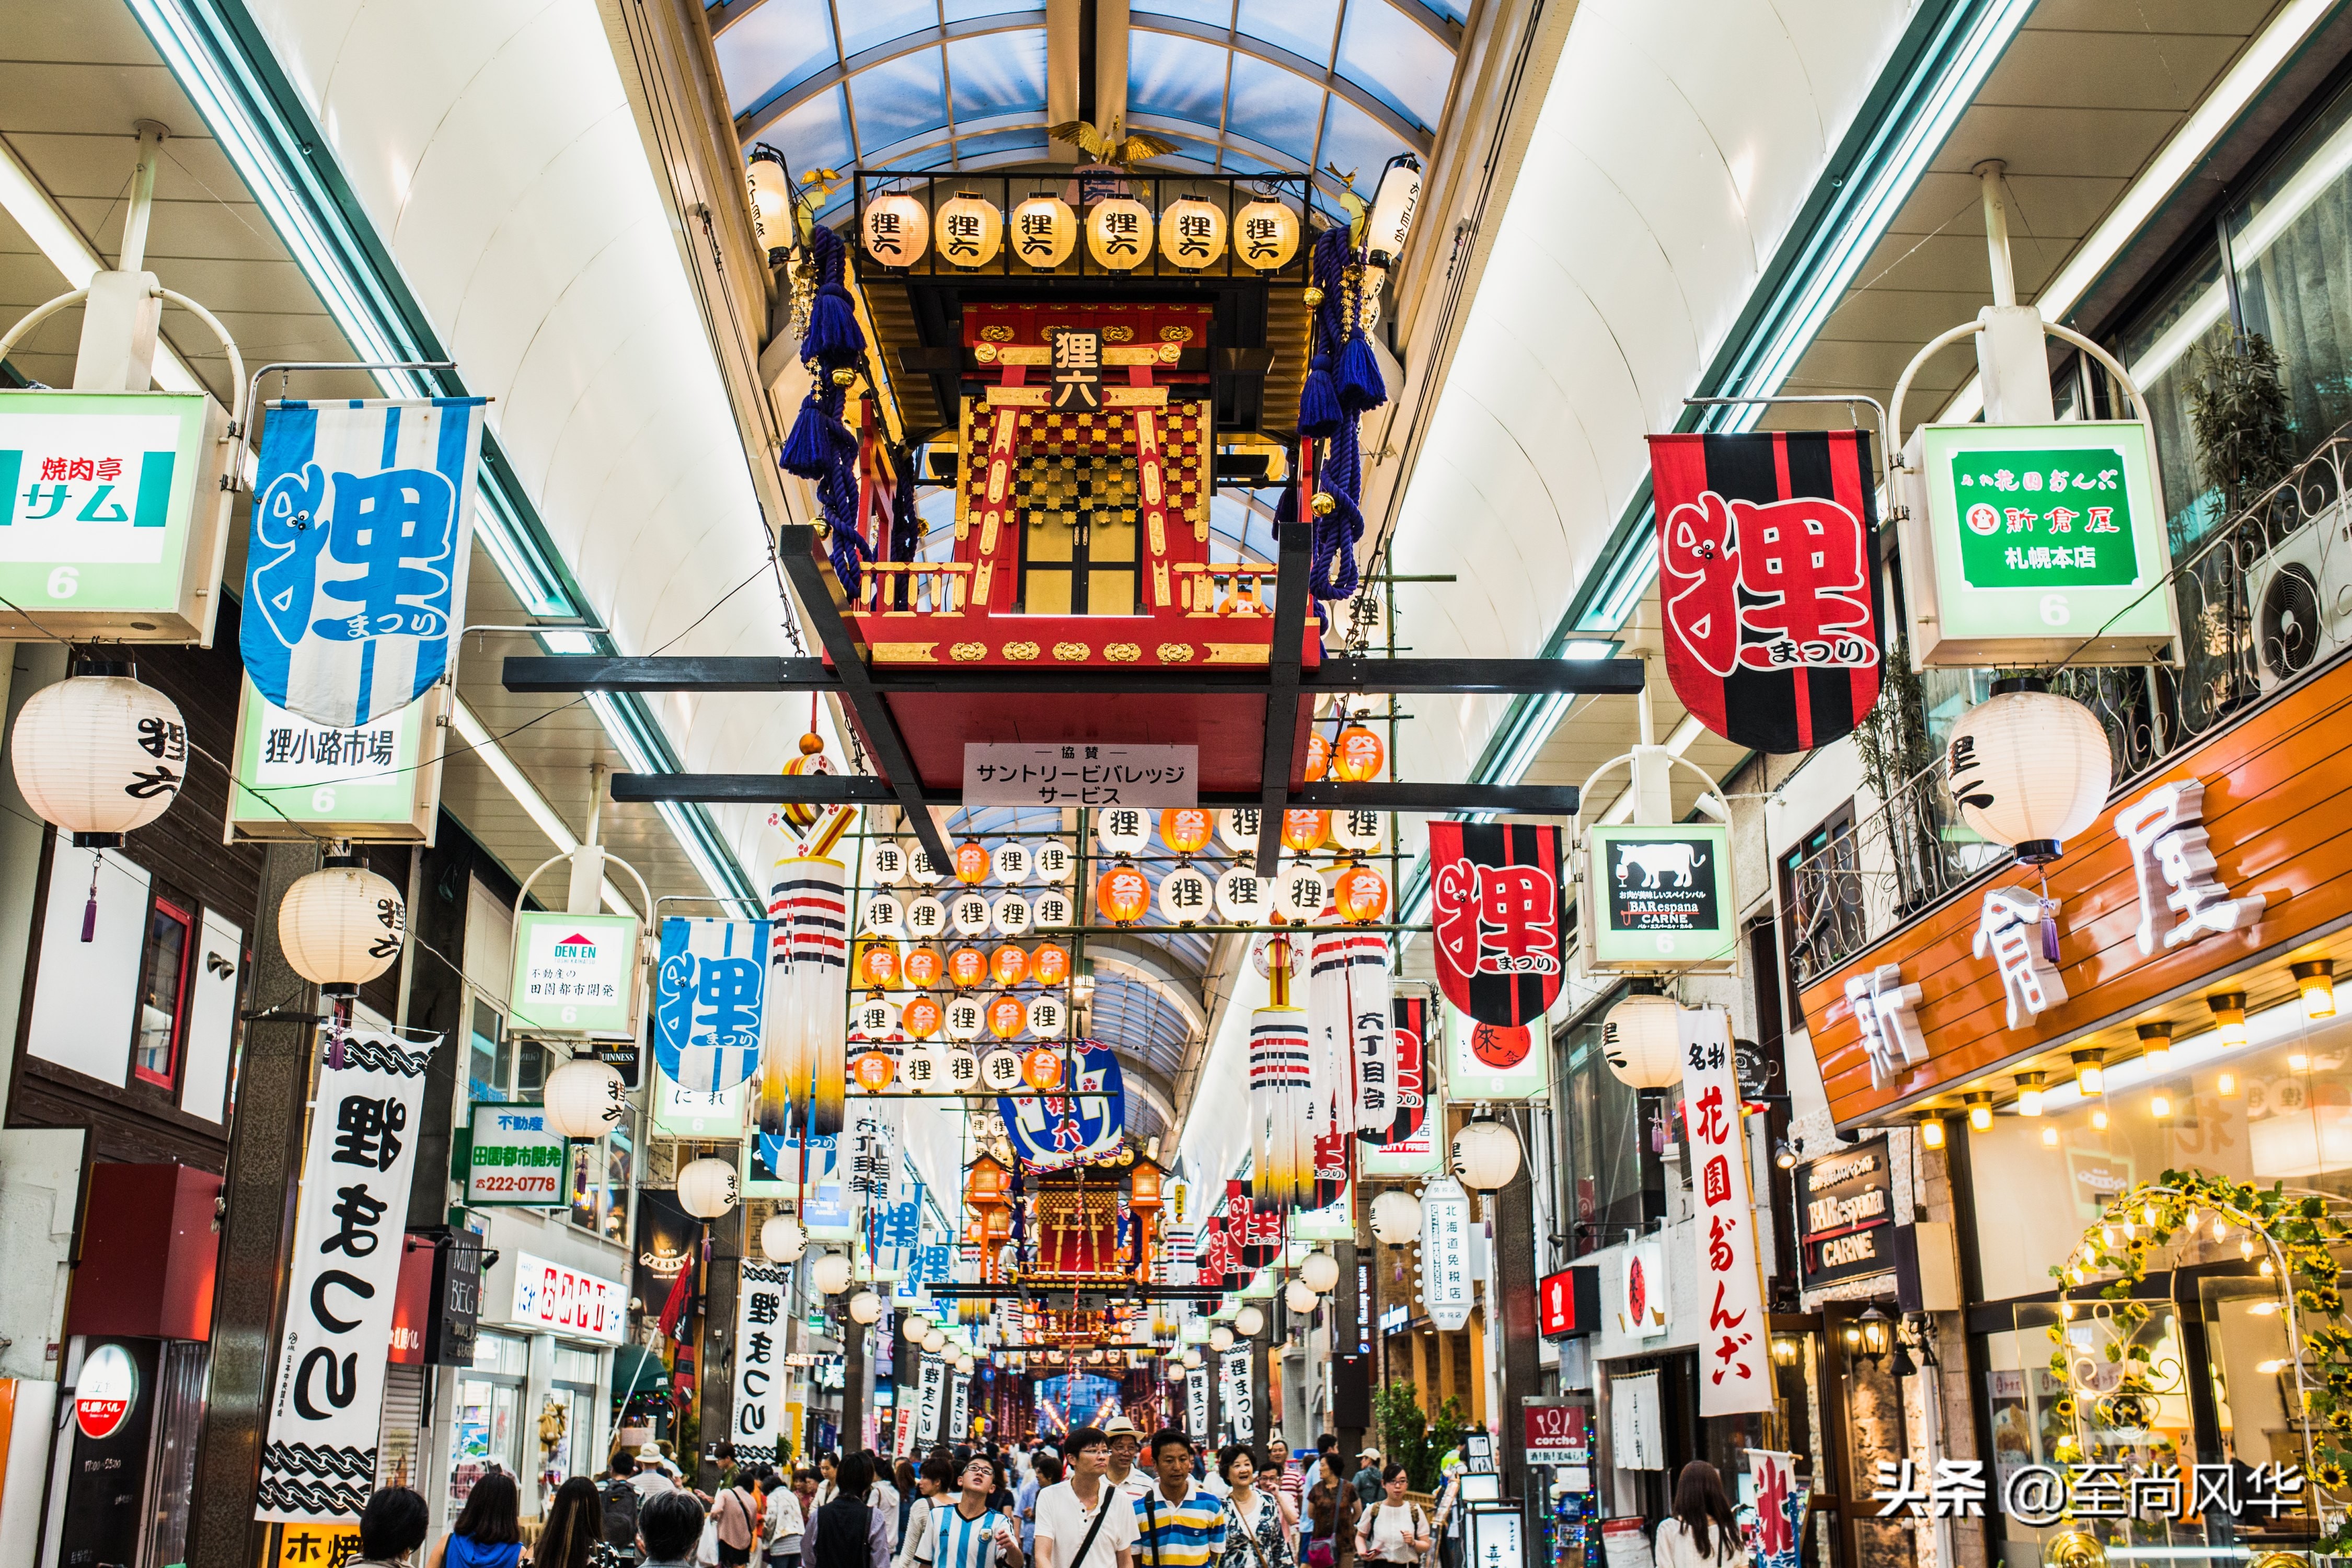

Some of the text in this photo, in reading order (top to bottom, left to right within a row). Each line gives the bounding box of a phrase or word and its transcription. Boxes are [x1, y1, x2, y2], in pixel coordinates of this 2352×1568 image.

[871, 212, 902, 255] 狸六
[948, 214, 979, 257] 狸六
[1021, 213, 1053, 256] 狸六
[1106, 213, 1138, 256] 狸六
[1179, 215, 1211, 258] 狸六
[1246, 217, 1280, 259] 狸六
[1056, 332, 1097, 408] 狸六
[41, 457, 122, 482] 焼肉亭
[22, 484, 129, 523] サム
[2005, 506, 2120, 534] 新倉屋
[255, 462, 452, 649] 狸
[2004, 546, 2096, 569] 札幌本店
[47, 567, 79, 598] 6
[1663, 490, 1880, 677] 狸
[2038, 594, 2070, 626] 6
[347, 614, 437, 638] まつり
[1771, 640, 1864, 665] まつり
[266, 729, 394, 766] 狸小路市場
[1061, 746, 1099, 758] 協賛
[1347, 735, 1376, 766] 祭
[977, 765, 1184, 783] サントリービバレッジ
[312, 788, 336, 812] 6
[1039, 787, 1121, 805] サービス
[1111, 810, 1138, 836] 狸
[1175, 810, 1204, 840] 祭
[1348, 811, 1377, 836] 狸
[877, 850, 898, 871] 狸
[960, 850, 982, 872] 祭
[1001, 850, 1021, 871] 狸
[1042, 850, 1063, 870] 狸
[1112, 874, 1142, 905] 祭
[1172, 878, 1202, 907] 狸
[1229, 877, 1258, 904] 狸
[1292, 879, 1321, 908] 狸
[1352, 875, 1380, 907] 祭
[870, 903, 892, 924] 狸
[914, 905, 935, 926] 狸
[961, 902, 983, 924] 狸
[1002, 902, 1024, 924] 狸
[1042, 900, 1063, 921] 狸
[1437, 859, 1560, 978] 狸
[1641, 914, 1688, 924] CARNE
[1656, 933, 1675, 952] 6
[1844, 778, 2266, 1091] 新倉屋
[555, 946, 595, 958] DEN EN
[956, 952, 978, 974] 祭
[1001, 950, 1023, 972] 祭
[1041, 951, 1063, 973] 祭
[532, 969, 575, 979] 不動産の
[871, 953, 893, 975] 祭
[911, 954, 932, 977] 祭
[1498, 956, 1551, 971] まつり
[531, 983, 614, 997] 田園都市開発
[658, 952, 763, 1051] 狸
[561, 1007, 577, 1023] 6
[864, 1008, 886, 1029] 狸
[914, 1006, 935, 1029] 祭
[953, 1008, 975, 1029] 狸
[996, 1004, 1019, 1027] 祭
[1034, 1006, 1056, 1027] 狸
[707, 1034, 752, 1046] まつり
[601, 1053, 634, 1062] UINNESS
[1034, 1054, 1056, 1078] 祭
[1688, 1042, 1725, 1071] 名物
[861, 1059, 883, 1080] 祭
[909, 1059, 931, 1081] 狸
[952, 1058, 973, 1079] 狸
[994, 1057, 1016, 1079] 狸
[1491, 1077, 1505, 1092] 6
[675, 1090, 725, 1105] にれ
[498, 1116, 543, 1131] 不動産
[693, 1120, 704, 1132] 6
[472, 1146, 561, 1167] 田園都市開発
[1399, 1158, 1409, 1169] 6
[487, 1177, 555, 1191] 222-0778
[771, 1183, 781, 1193] 6
[1320, 1227, 1328, 1236] 6
[454, 1239, 477, 1274] MINI
[1446, 1205, 1460, 1299] 北海道免税店
[1823, 1231, 1875, 1267] CARNE
[450, 1279, 474, 1315] BEG
[541, 1268, 605, 1332] おみやげ
[1190, 1376, 1204, 1429] 狸まつり
[1231, 1358, 1254, 1432] 狸まつり
[80, 1401, 121, 1412] 札幌バル
[1535, 1435, 1577, 1446] corcho
